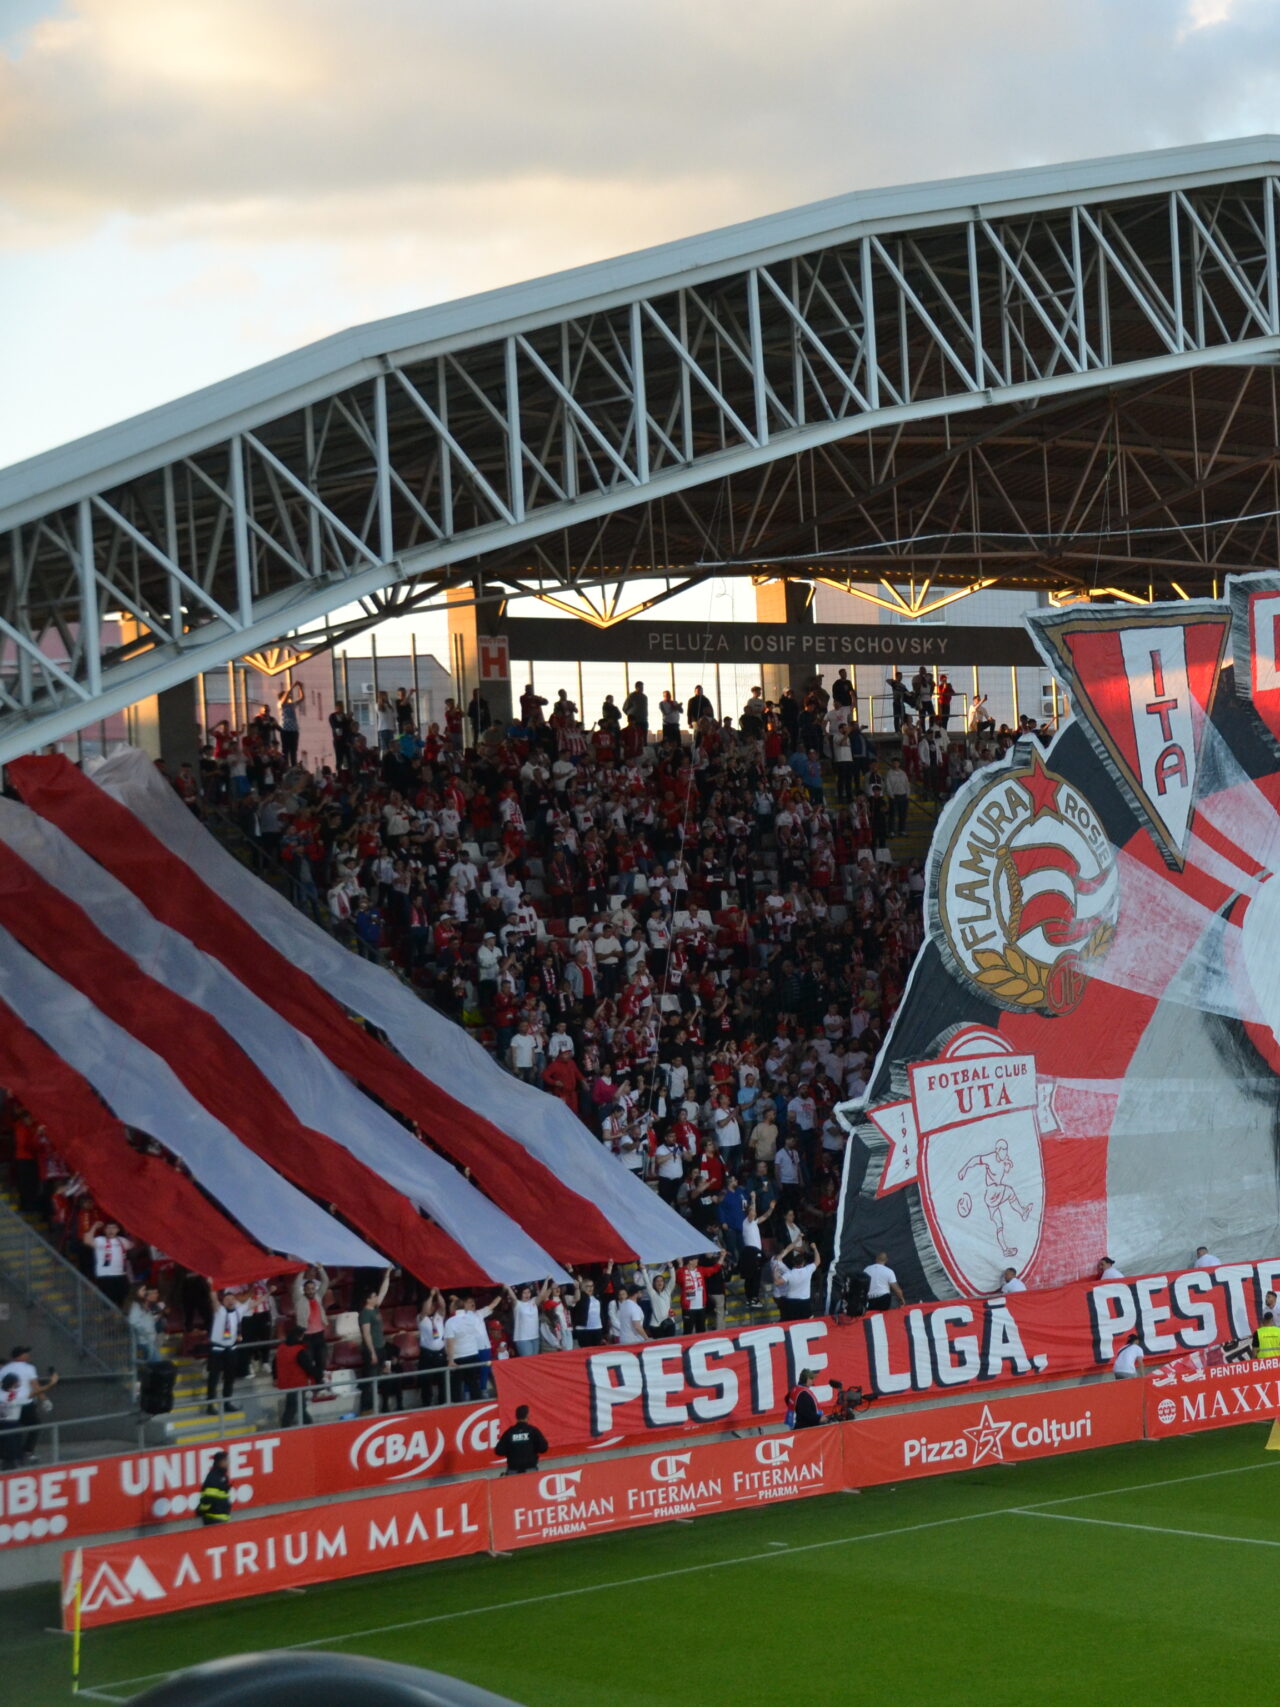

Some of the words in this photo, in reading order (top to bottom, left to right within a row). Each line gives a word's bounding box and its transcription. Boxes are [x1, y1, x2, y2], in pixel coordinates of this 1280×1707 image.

[649, 633, 729, 651] PELUZA
[744, 636, 796, 652] IOSIF
[802, 636, 949, 655] PETSCHOVSKY
[481, 647, 507, 678] H
[1146, 649, 1189, 796] ITA
[955, 785, 1029, 951] FLAMURA
[1064, 792, 1111, 870] ROSIE
[927, 1066, 990, 1091] FOTBAL
[995, 1063, 1028, 1078] CLUB
[955, 1083, 1014, 1114] UTA
[590, 1320, 832, 1438] PESTE
[1210, 1362, 1250, 1378] PENTRU
[366, 1434, 428, 1468] CBA
[904, 1437, 967, 1466] Pizza
[734, 1461, 823, 1493] FITERMAN
[758, 1485, 798, 1499] PHARMA
[628, 1478, 722, 1510] FITERMAN
[514, 1496, 614, 1531] FITERMAN
[654, 1502, 696, 1518] PHARMA
[542, 1521, 586, 1537] PHARMA
[174, 1526, 347, 1588] ATRIUM
[369, 1502, 479, 1551] MALL
